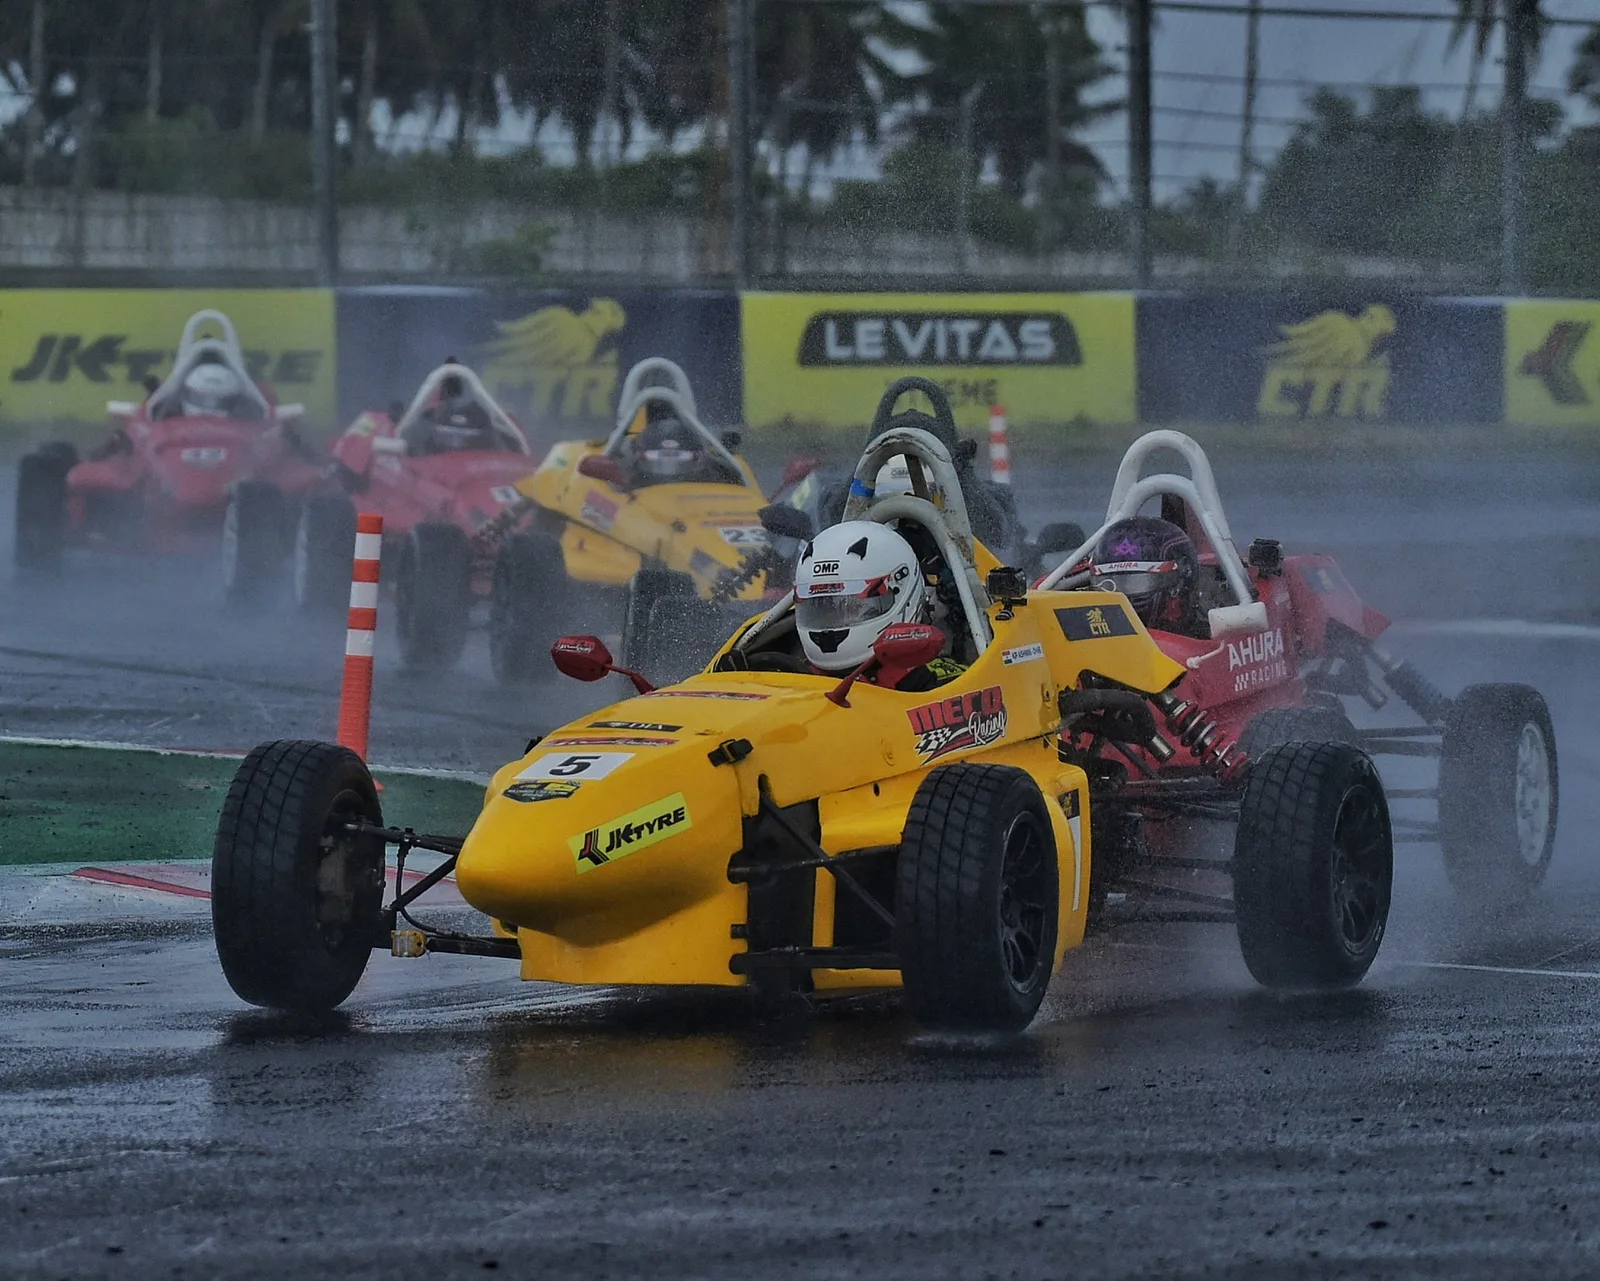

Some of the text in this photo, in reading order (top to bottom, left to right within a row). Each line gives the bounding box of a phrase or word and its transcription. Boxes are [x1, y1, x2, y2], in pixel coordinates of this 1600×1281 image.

[825, 319, 1056, 360] LEVITAS
[1257, 369, 1389, 416] CTR
[813, 562, 839, 574] OMP
[1089, 622, 1111, 635] CTR
[1227, 628, 1284, 672] AHURA
[549, 756, 602, 776] 5
